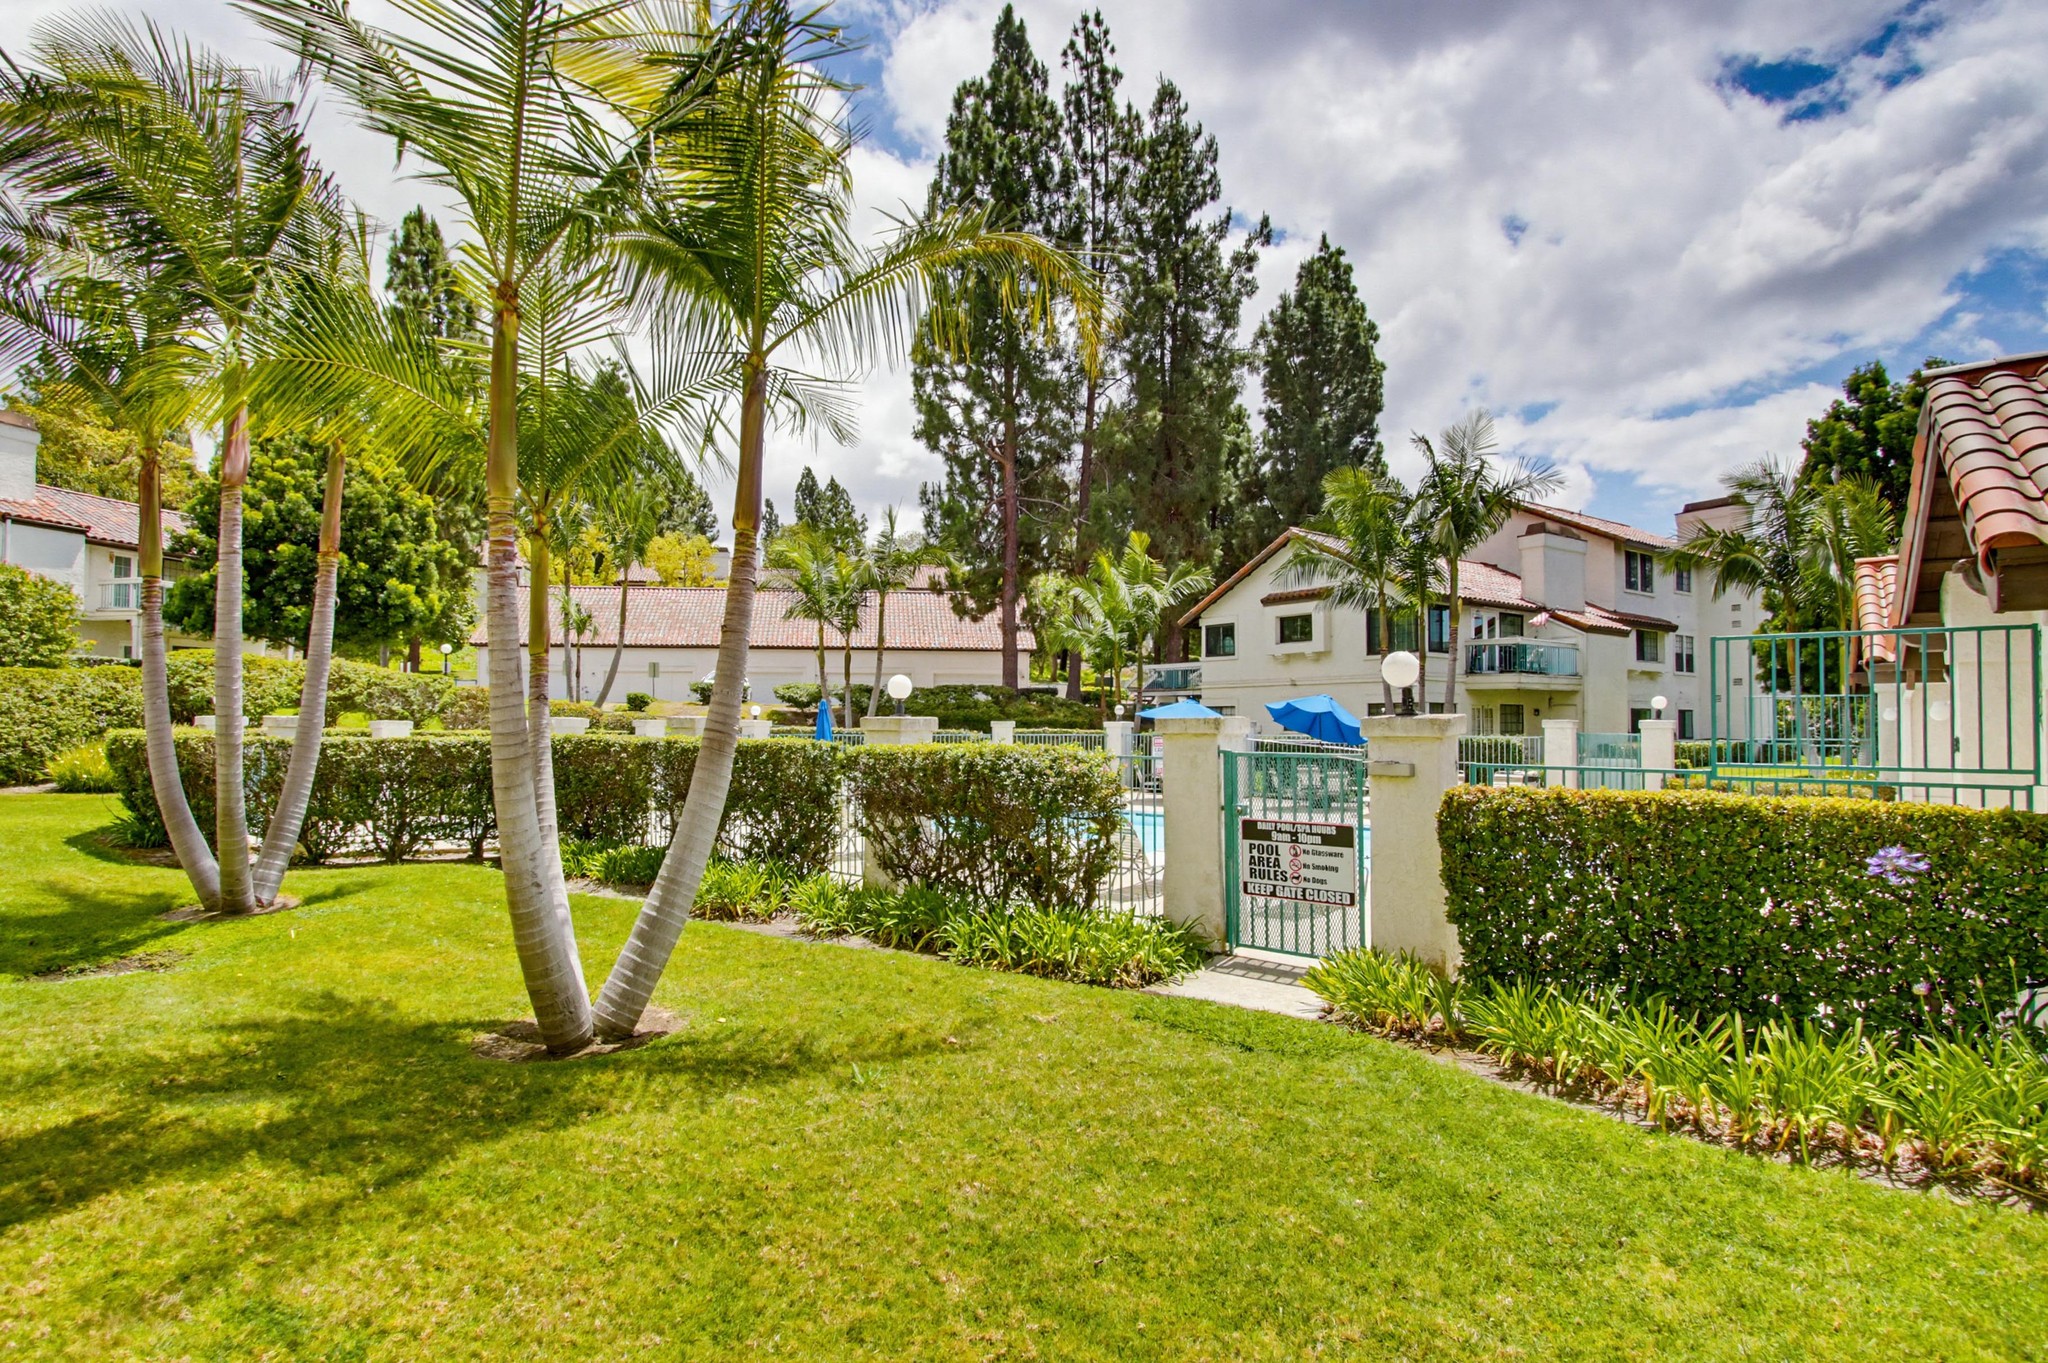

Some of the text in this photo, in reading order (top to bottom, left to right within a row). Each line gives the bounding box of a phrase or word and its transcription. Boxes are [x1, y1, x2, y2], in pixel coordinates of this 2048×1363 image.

[1257, 822, 1336, 835] DAILY POOL/SPA HOURS
[1271, 831, 1291, 841] 9am
[1297, 833, 1321, 844] 10pm
[1249, 843, 1281, 856] POOL
[1312, 849, 1344, 858] Glassware
[1249, 855, 1281, 869] AREA
[1312, 863, 1339, 873] Smoking
[1250, 867, 1288, 882] RULES
[1312, 877, 1328, 885] Dogs
[1247, 883, 1351, 905] KEEP GATE CLOSED
